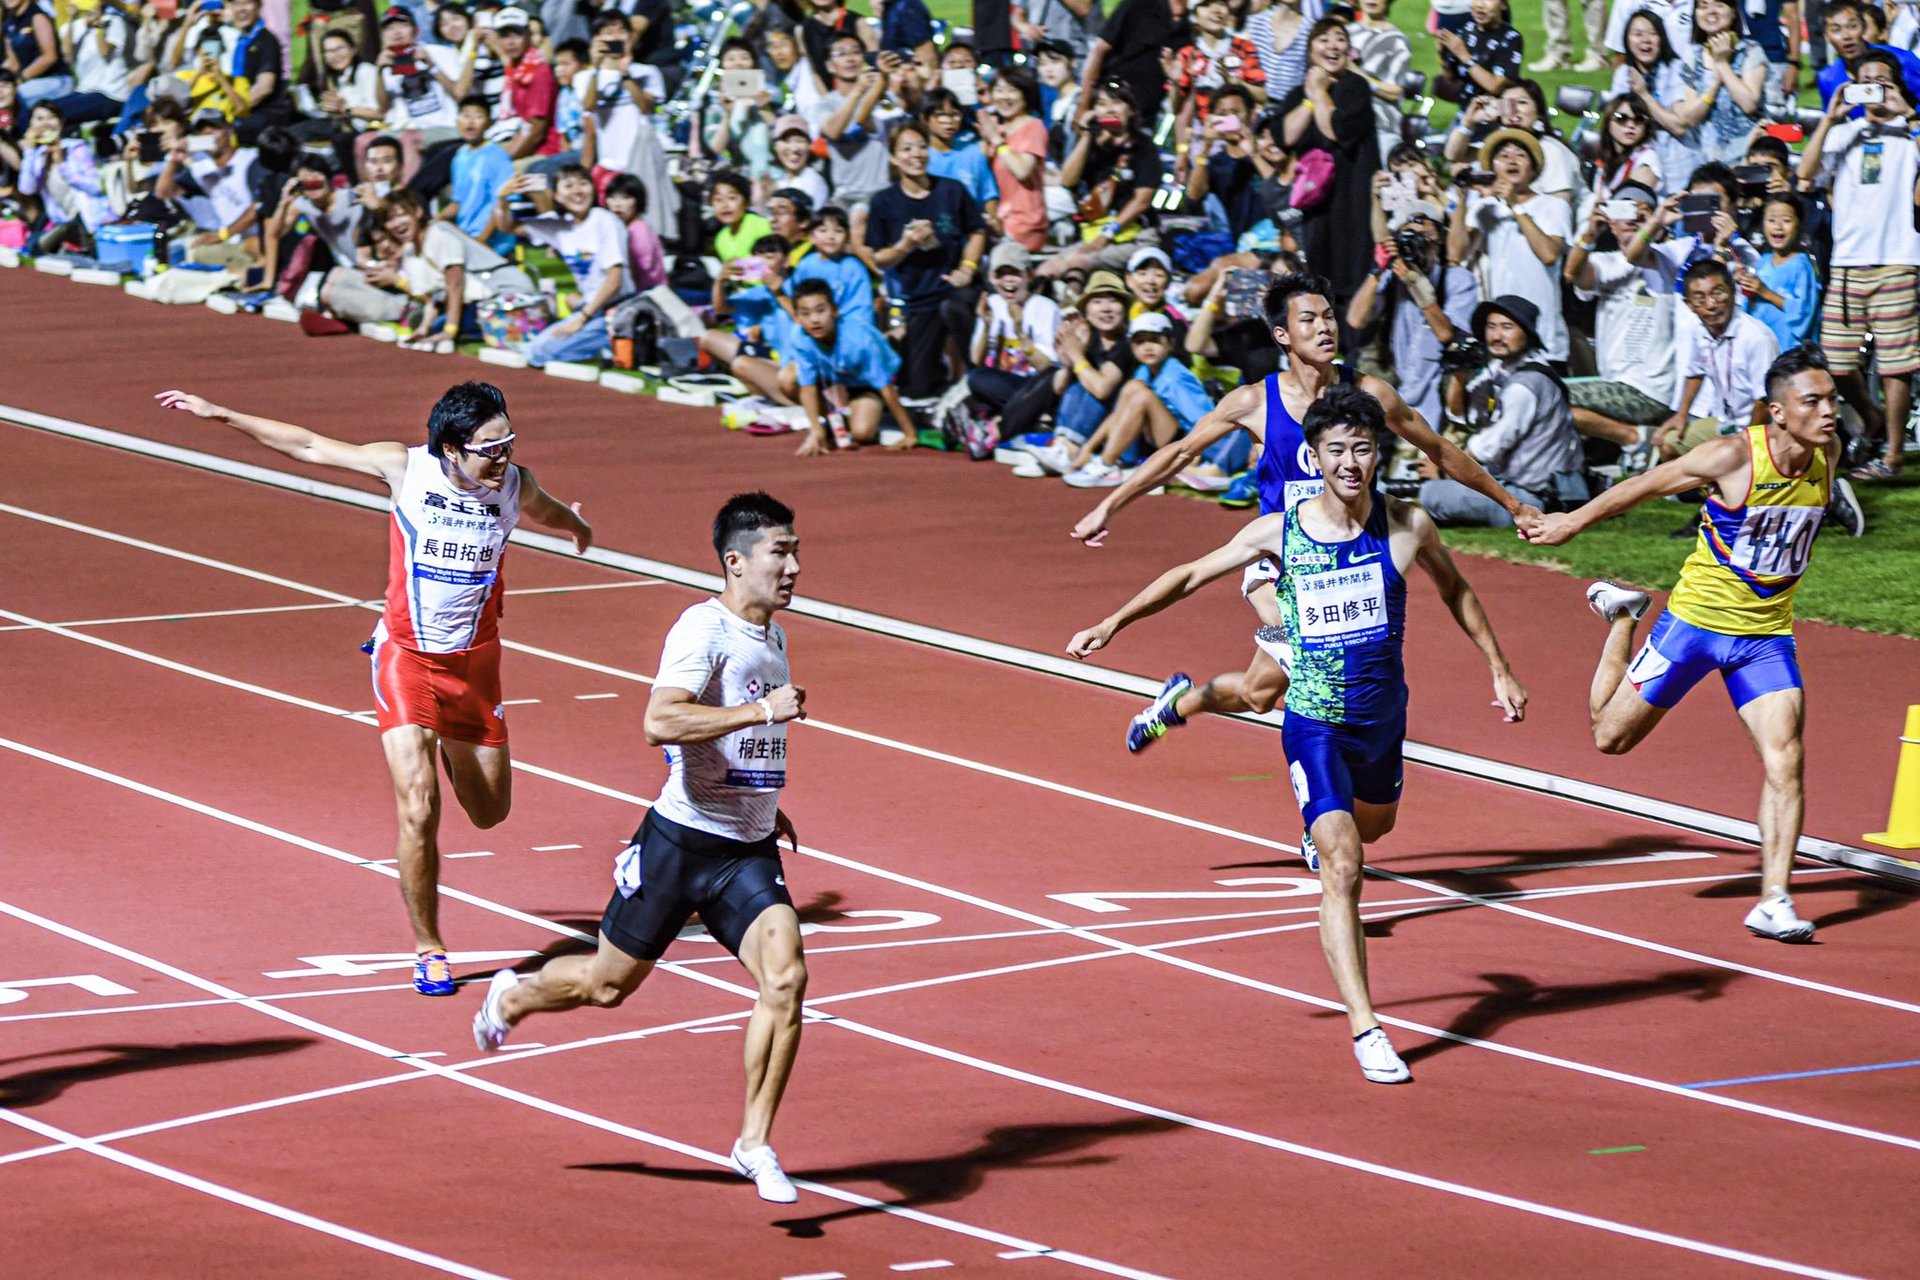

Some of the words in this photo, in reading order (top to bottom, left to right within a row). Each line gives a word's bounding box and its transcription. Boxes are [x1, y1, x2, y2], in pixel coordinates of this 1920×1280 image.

[424, 491, 501, 517] 富士通
[423, 538, 494, 562] 長田拓也
[1748, 511, 1814, 574] 440
[1313, 571, 1373, 590] 福井新聞社
[1305, 597, 1380, 626] 多田修平
[738, 737, 786, 760] 桐生祥
